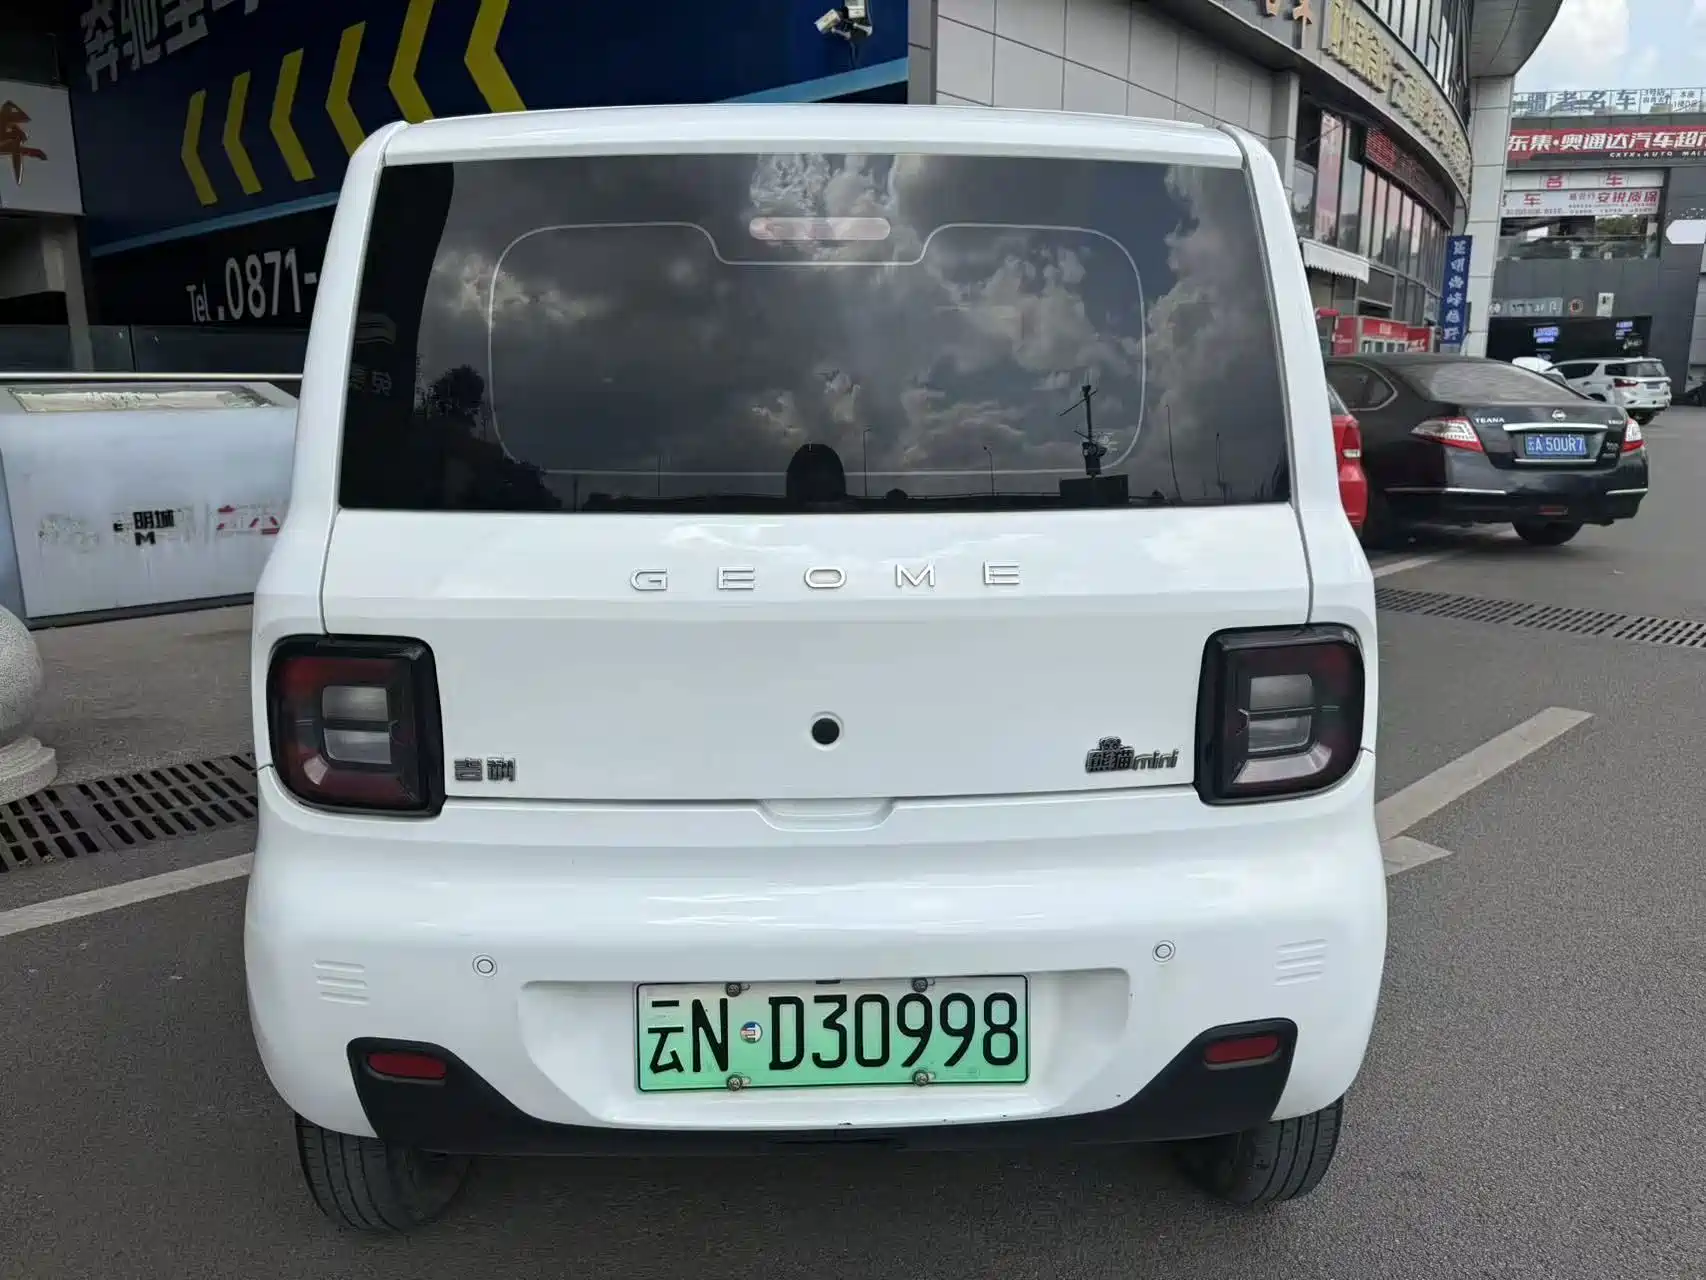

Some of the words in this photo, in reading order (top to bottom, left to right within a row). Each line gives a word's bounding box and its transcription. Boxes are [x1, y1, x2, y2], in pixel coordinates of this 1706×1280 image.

[80, 0, 259, 92] 奔驰宝
[630, 559, 1022, 592] GEOME
